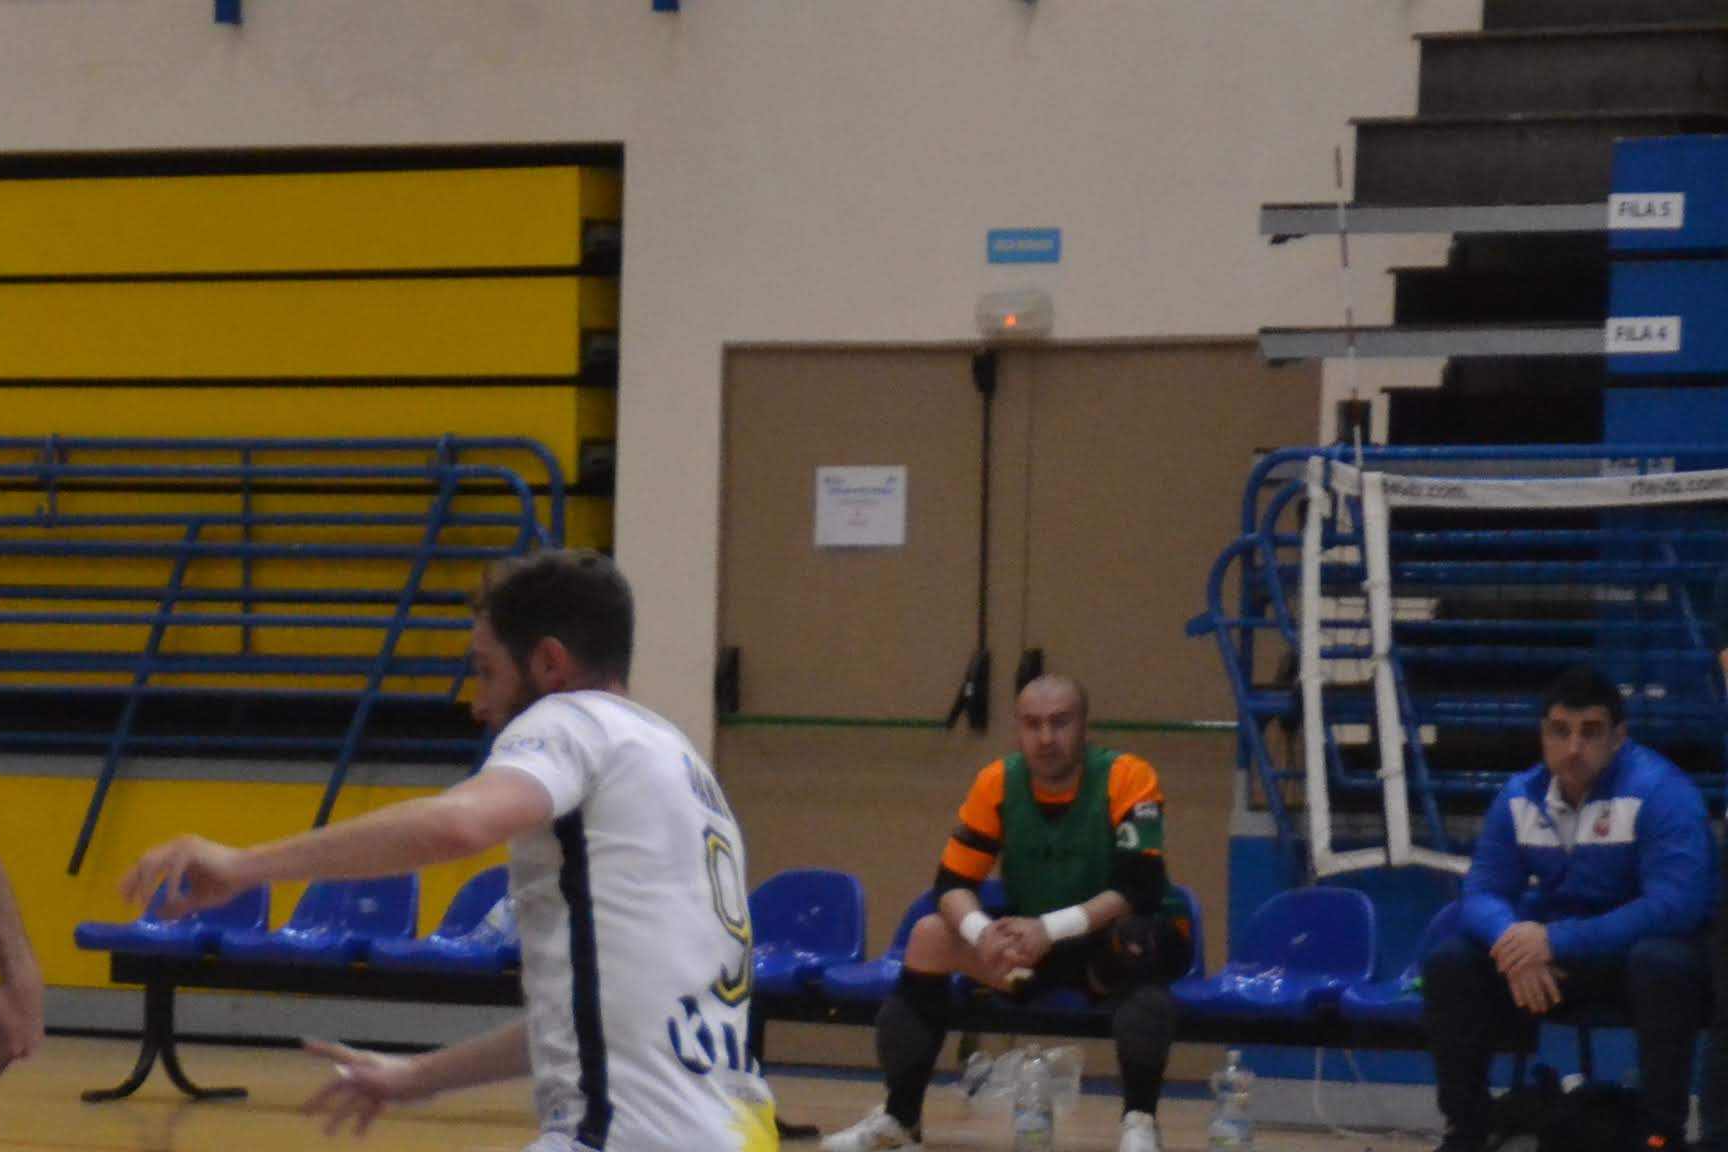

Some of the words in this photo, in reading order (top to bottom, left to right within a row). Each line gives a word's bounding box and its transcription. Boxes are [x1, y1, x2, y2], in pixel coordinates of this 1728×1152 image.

[1617, 201, 1657, 218] FILA
[1614, 324, 1653, 341] FILA
[702, 823, 753, 1008] 9
